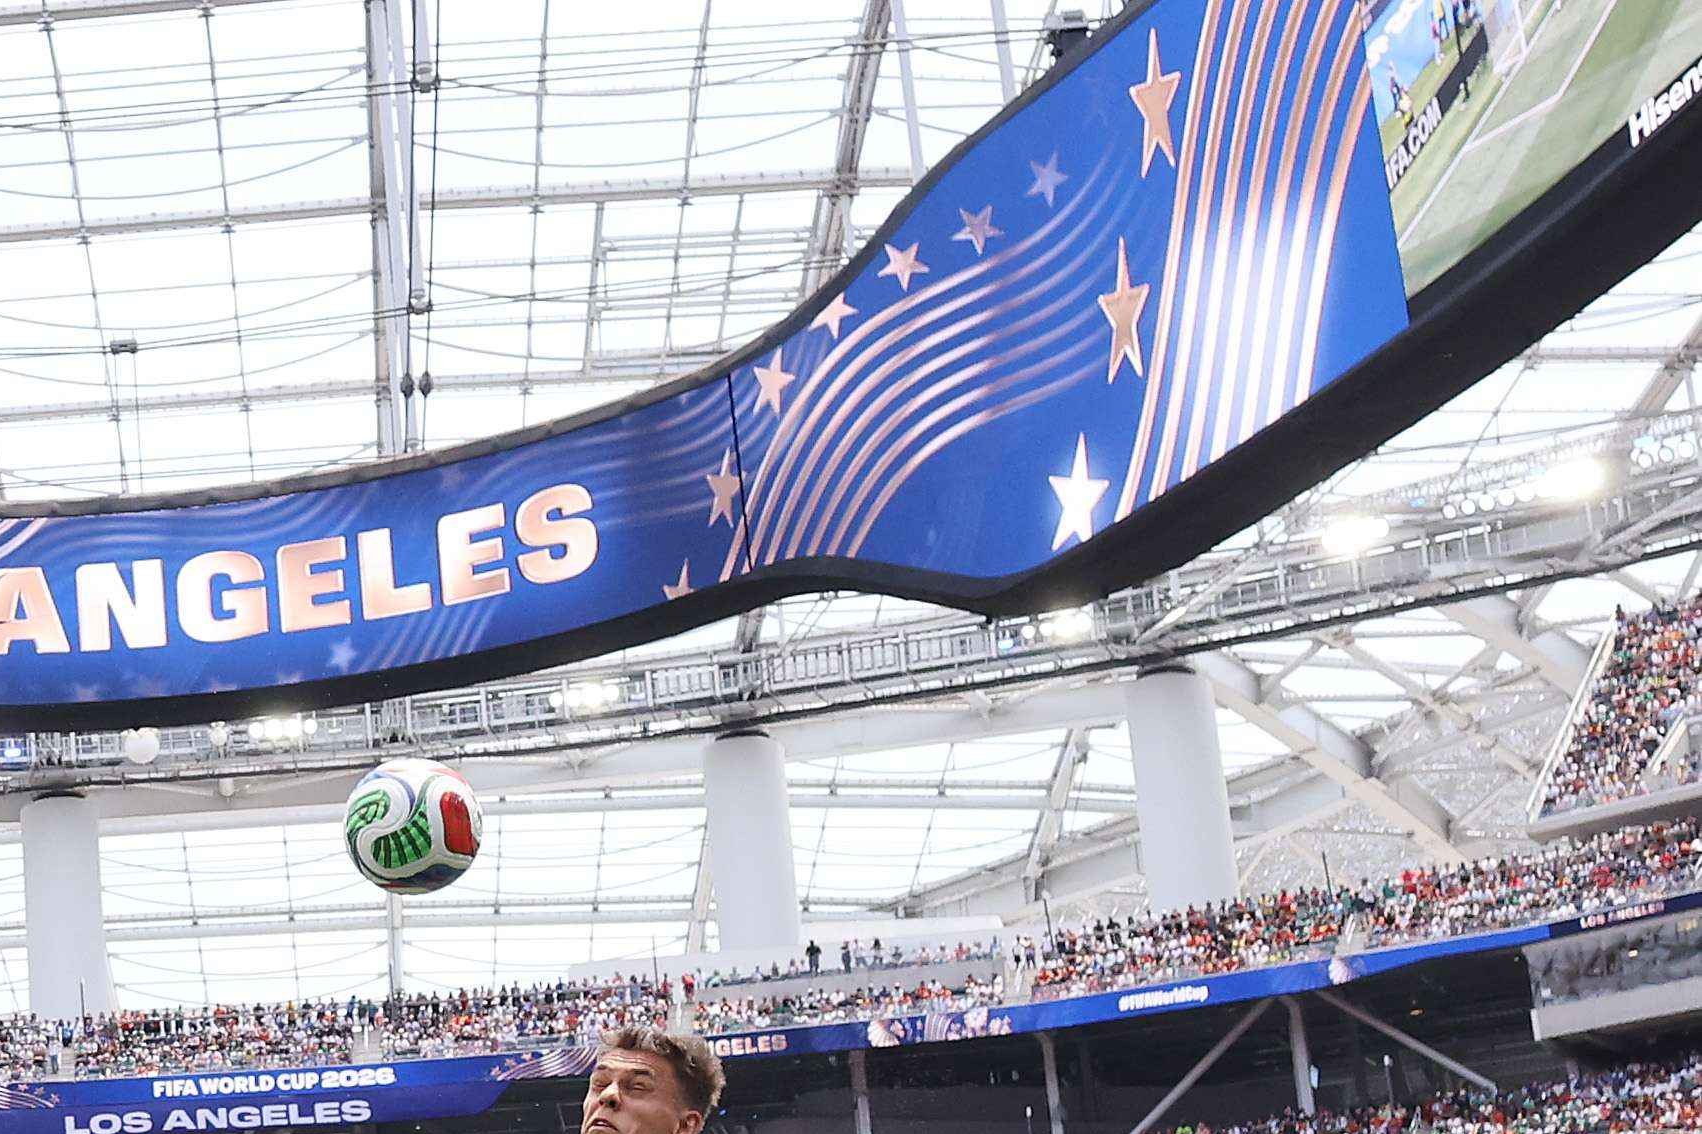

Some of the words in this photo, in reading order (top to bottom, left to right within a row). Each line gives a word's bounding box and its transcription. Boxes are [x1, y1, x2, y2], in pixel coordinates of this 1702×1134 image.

[708, 1034, 788, 1057] GELES
[152, 1079, 197, 1098] FIFA
[200, 1074, 275, 1095] WORLD
[276, 1070, 319, 1091] CUP
[320, 1067, 396, 1088] 2026
[162, 1099, 372, 1131] ANGELES
